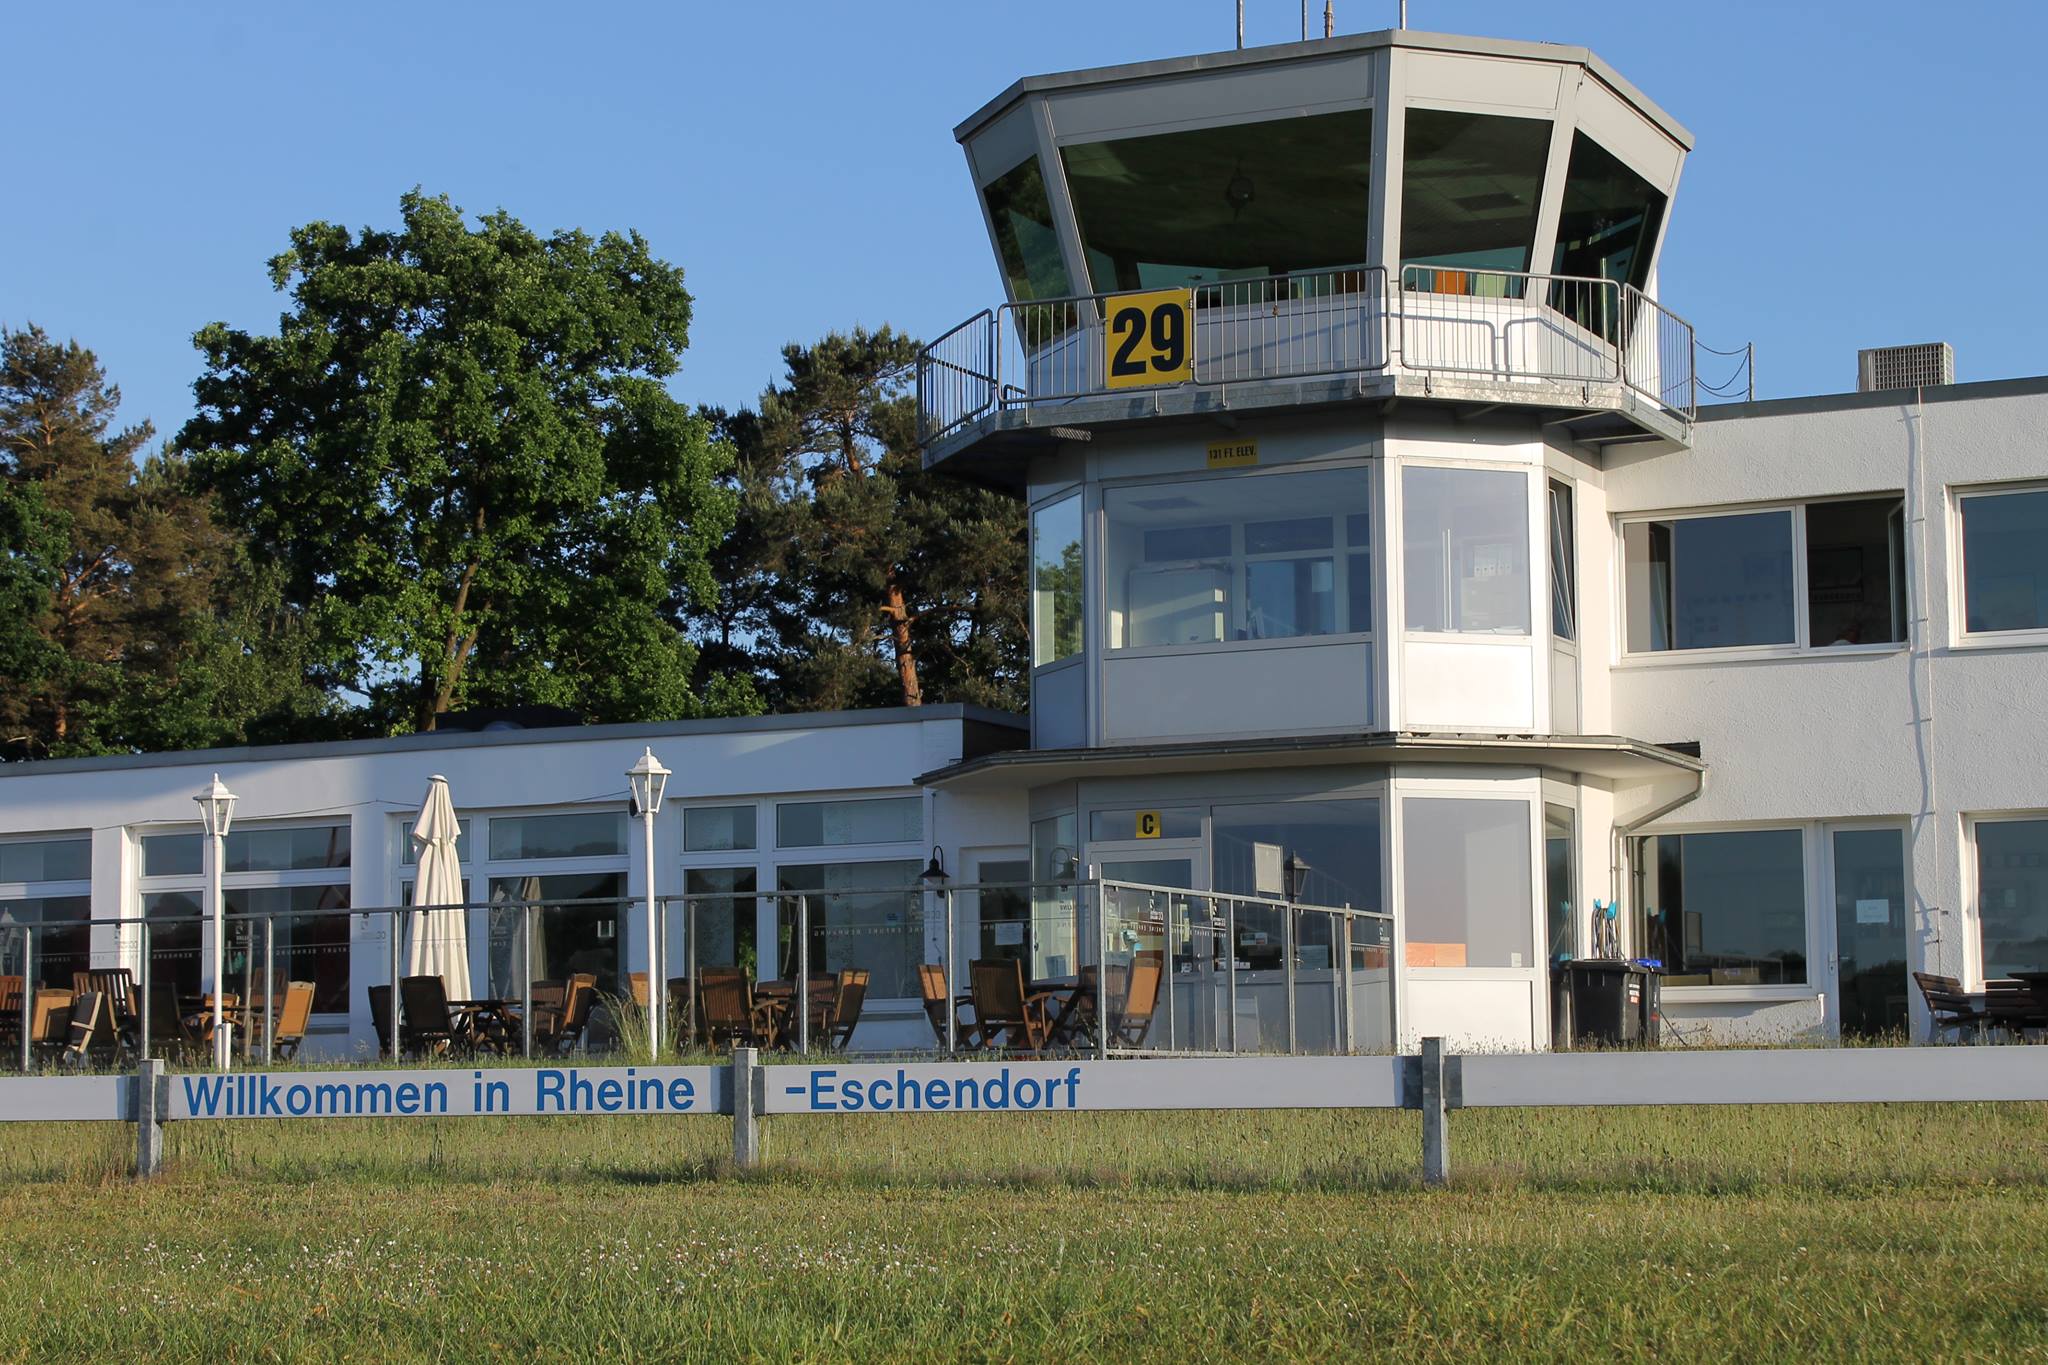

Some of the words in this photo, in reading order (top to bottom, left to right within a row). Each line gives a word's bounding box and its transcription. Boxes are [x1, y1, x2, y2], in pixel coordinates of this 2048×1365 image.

[1112, 303, 1184, 376] 29
[1142, 814, 1154, 834] C
[184, 1074, 448, 1117] Willkommen
[474, 1071, 510, 1112] in
[536, 1068, 695, 1111] Rheine
[786, 1068, 1081, 1110] -Eschendorf
